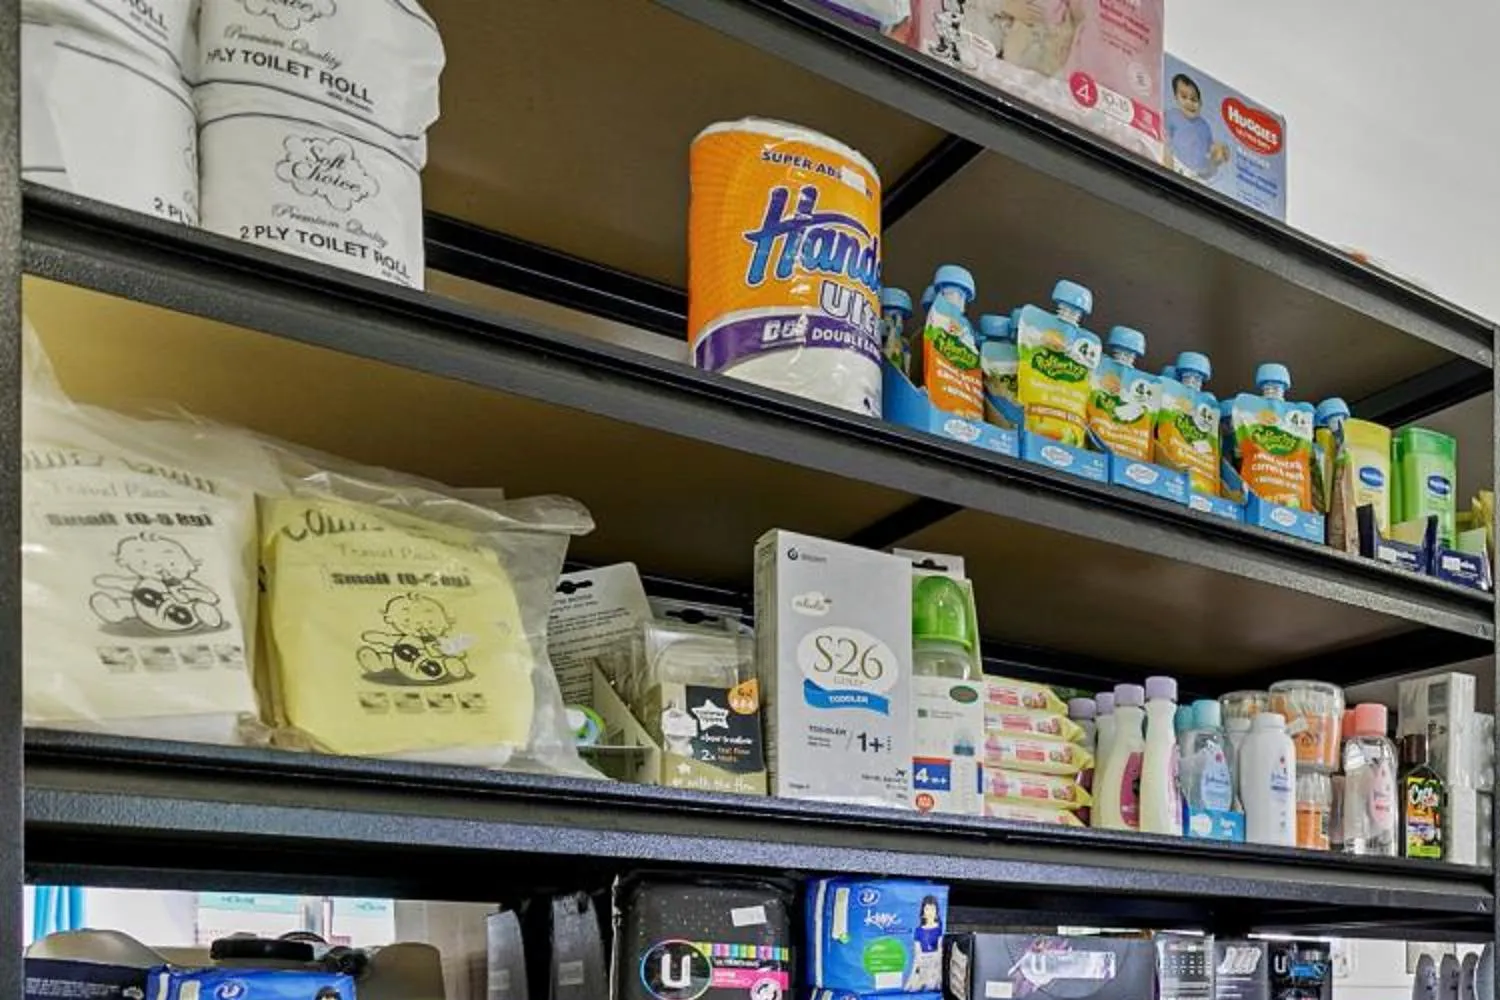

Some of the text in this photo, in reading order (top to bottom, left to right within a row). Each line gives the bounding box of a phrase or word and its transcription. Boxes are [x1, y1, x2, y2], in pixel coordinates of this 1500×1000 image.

[241, 49, 313, 80] TOILET
[319, 70, 374, 105] ROLL
[1227, 105, 1279, 145] HUGGIES
[304, 147, 346, 170] Soft
[761, 151, 813, 169] SUPER
[291, 160, 362, 193] Choice
[153, 197, 164, 212] 2
[239, 225, 411, 279] 2 PLY TOILET ROLL
[829, 695, 868, 705] TODDLER
